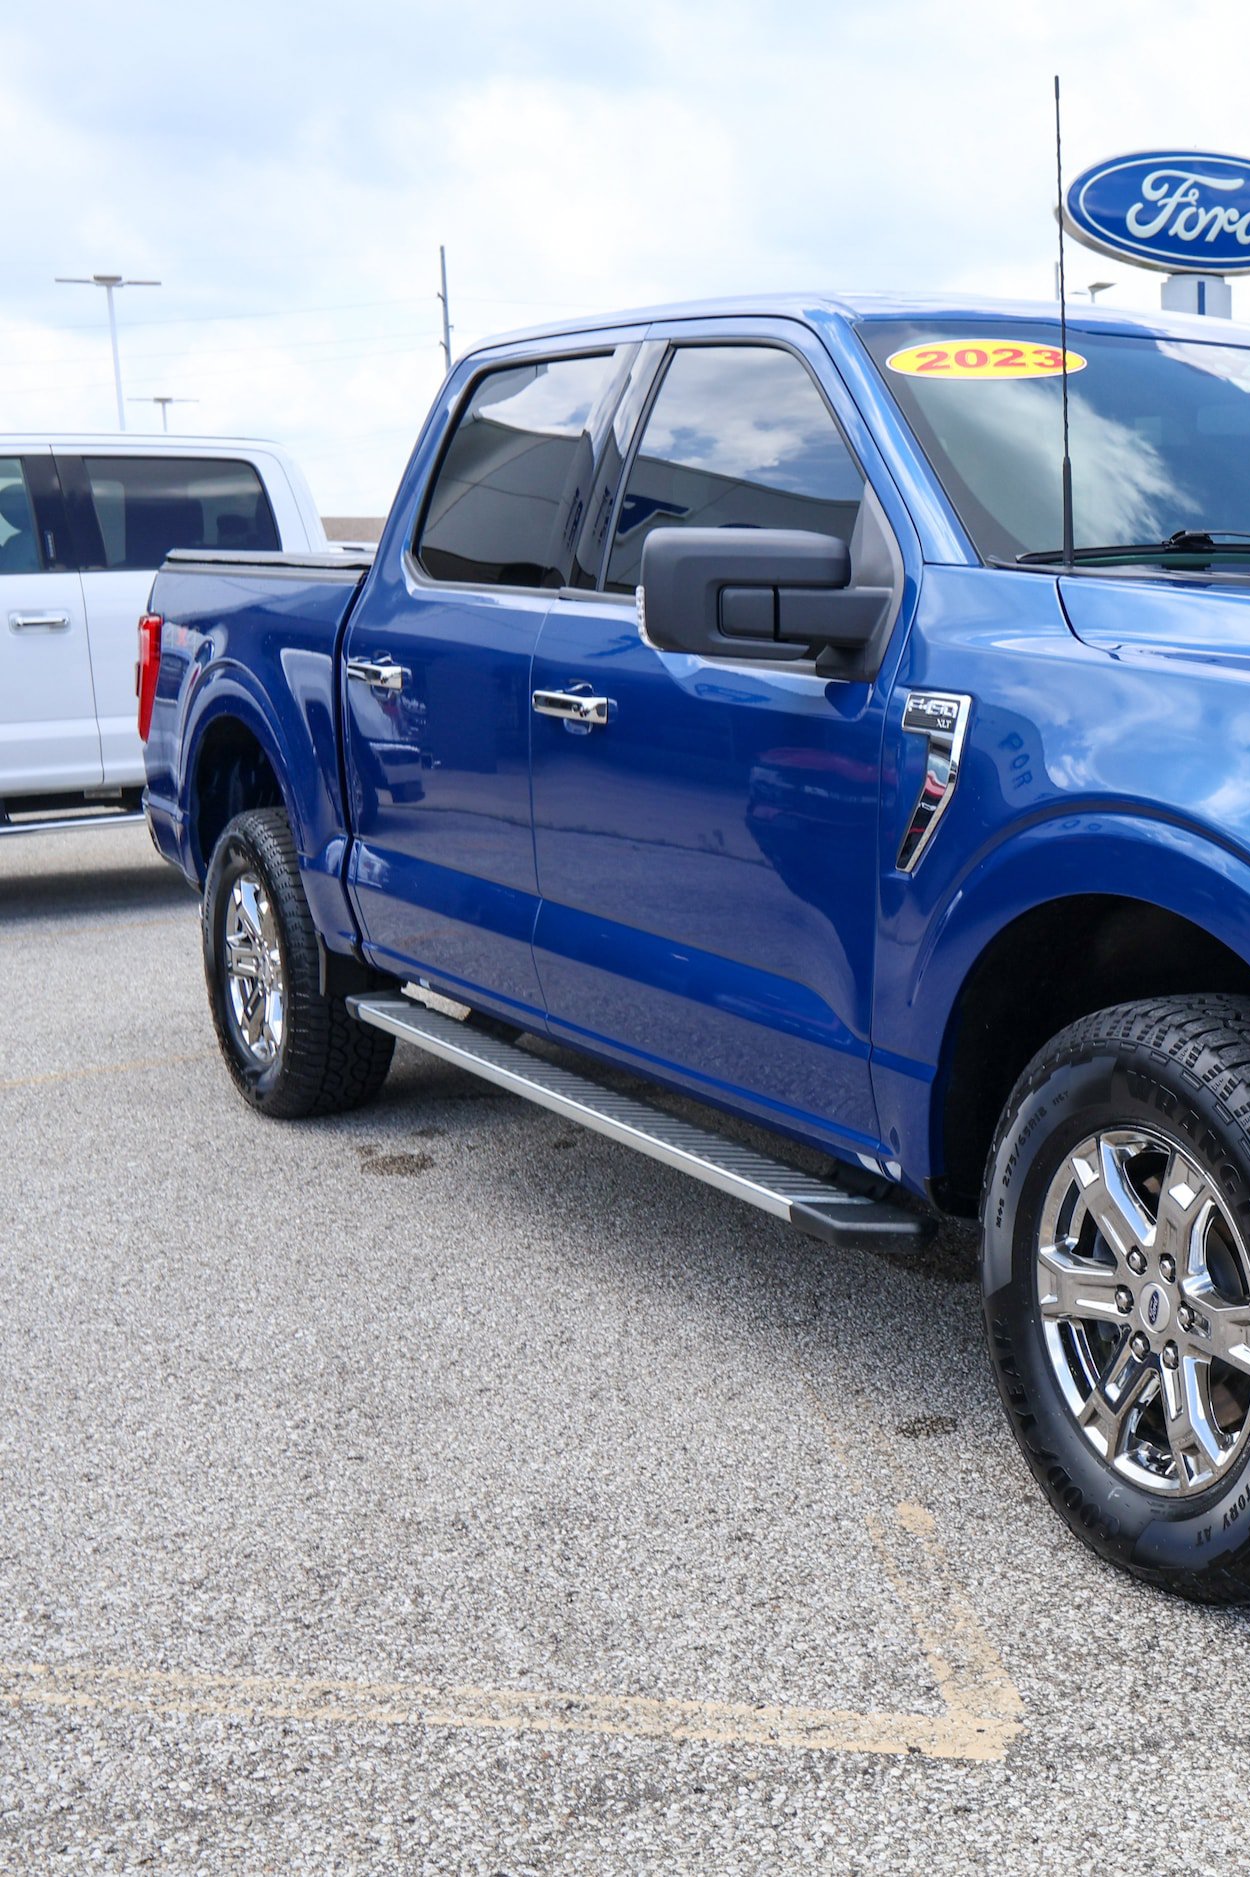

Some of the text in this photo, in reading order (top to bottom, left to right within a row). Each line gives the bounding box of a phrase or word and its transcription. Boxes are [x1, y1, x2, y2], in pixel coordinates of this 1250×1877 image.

[916, 348, 1067, 371] 2023
[936, 719, 951, 728] XLT
[992, 1316, 1121, 1542] GOODYEAR
[1195, 1525, 1212, 1547] AT
